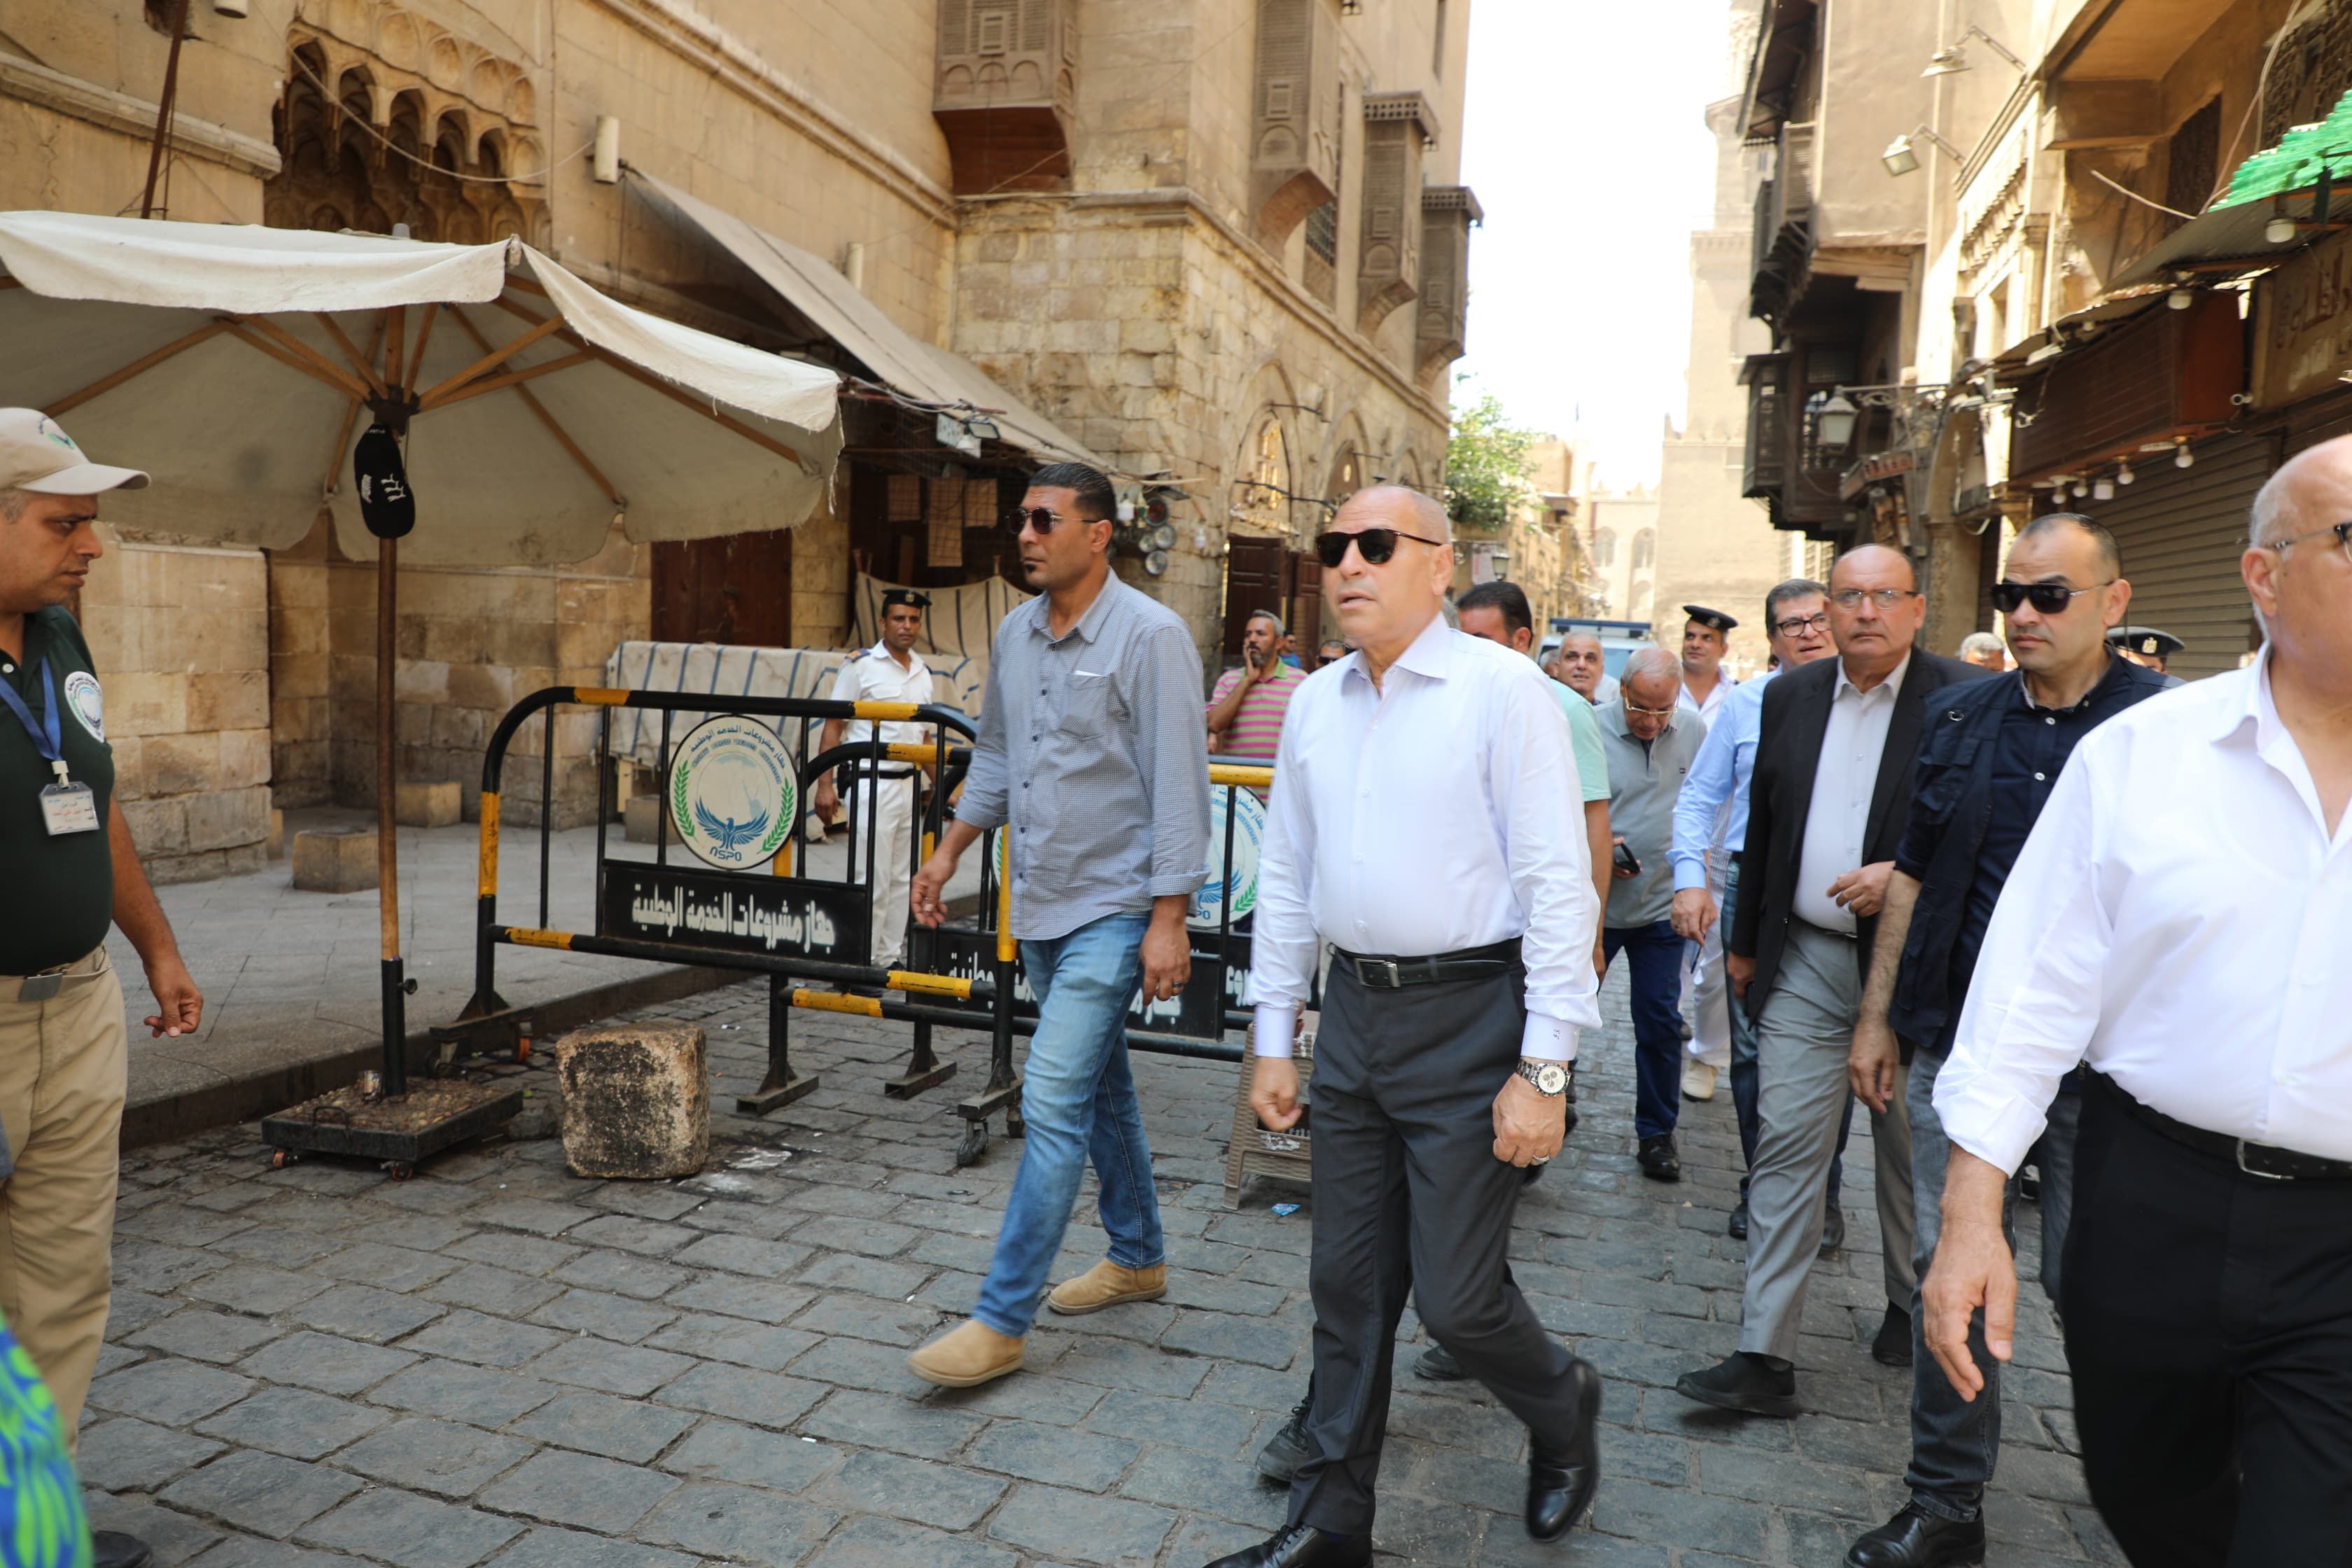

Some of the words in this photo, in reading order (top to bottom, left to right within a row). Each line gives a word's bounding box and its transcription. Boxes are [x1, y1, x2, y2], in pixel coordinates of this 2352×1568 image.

[686, 890, 732, 933] الخدمة
[732, 893, 804, 950] مشروعات
[803, 899, 836, 955] جهاز
